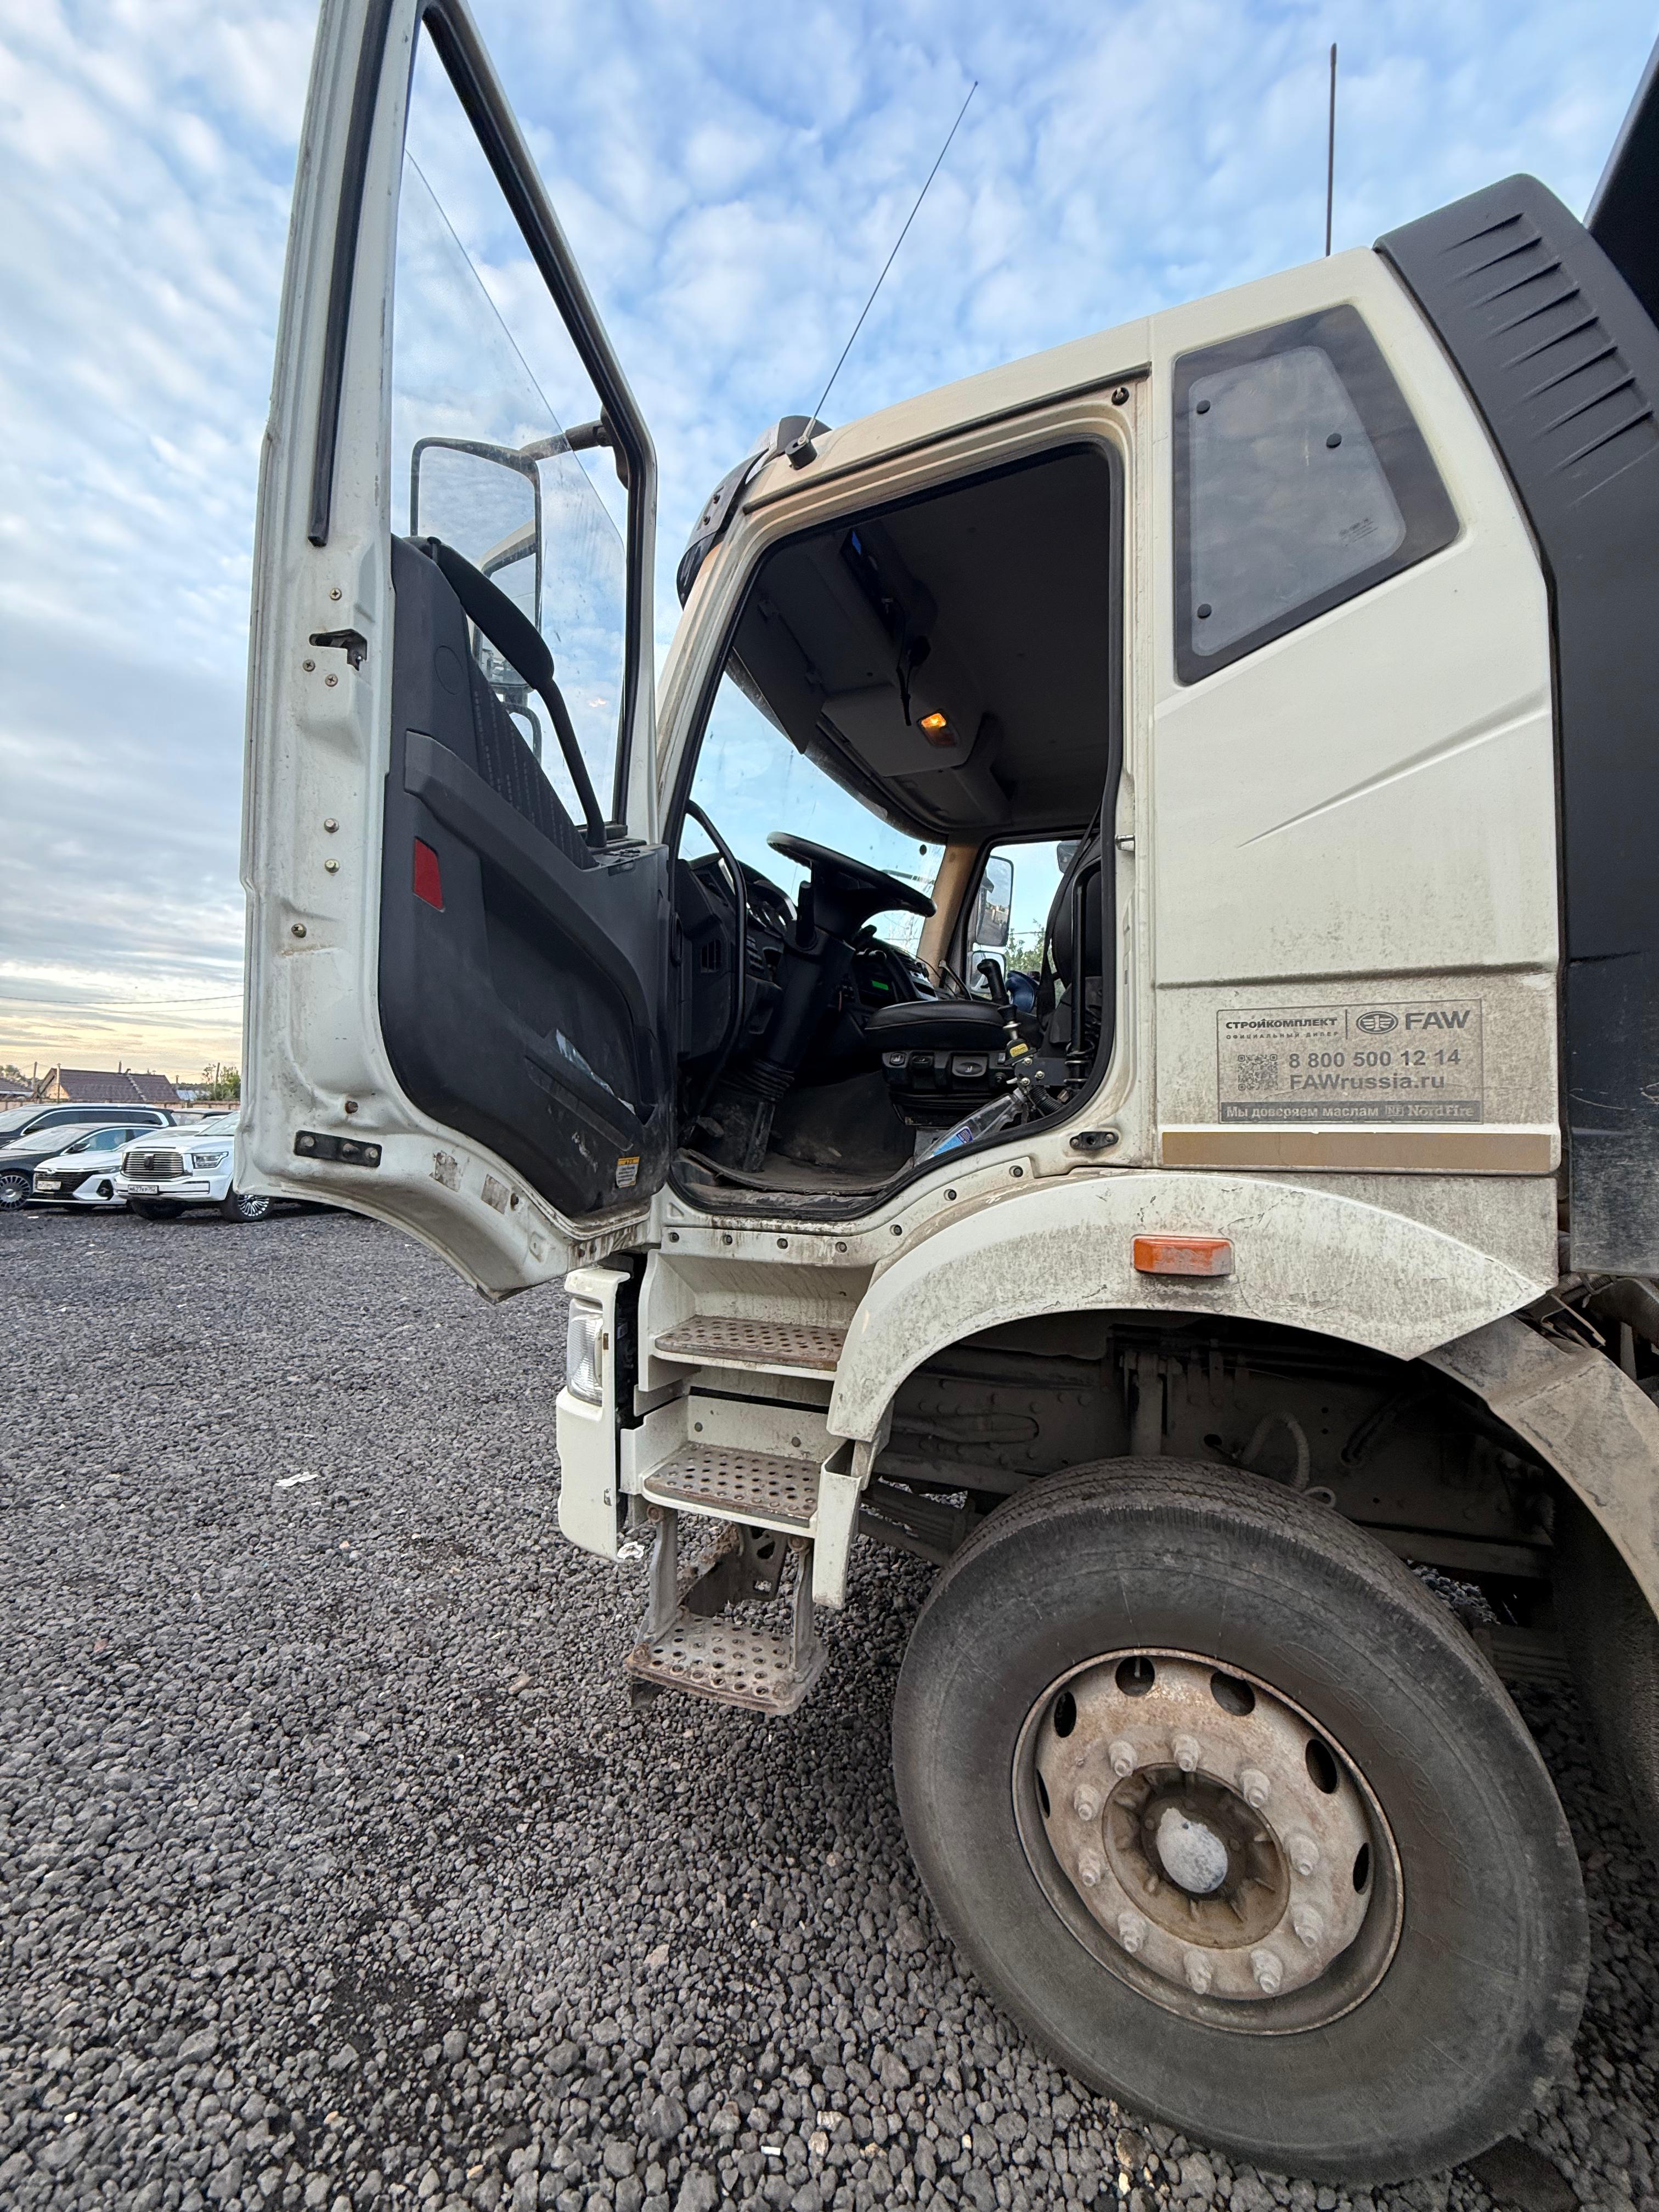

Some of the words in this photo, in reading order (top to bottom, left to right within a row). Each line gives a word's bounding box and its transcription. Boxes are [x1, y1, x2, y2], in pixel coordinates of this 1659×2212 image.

[1226, 1018, 1338, 1029] СТРОЙКОМПЛЕКТ
[1405, 1010, 1471, 1030] FAW
[1289, 1053, 1301, 1069] 8
[1307, 1052, 1345, 1068] 800
[1353, 1050, 1392, 1067] 500
[1400, 1049, 1426, 1066] 12
[1435, 1048, 1462, 1065] 14
[1290, 1073, 1445, 1090] FAWrussia.ru
[1226, 1106, 1249, 1118] Мы
[1322, 1106, 1379, 1117] маслам
[1386, 1105, 1403, 1116] NF
[1408, 1104, 1475, 1116] NordFire
